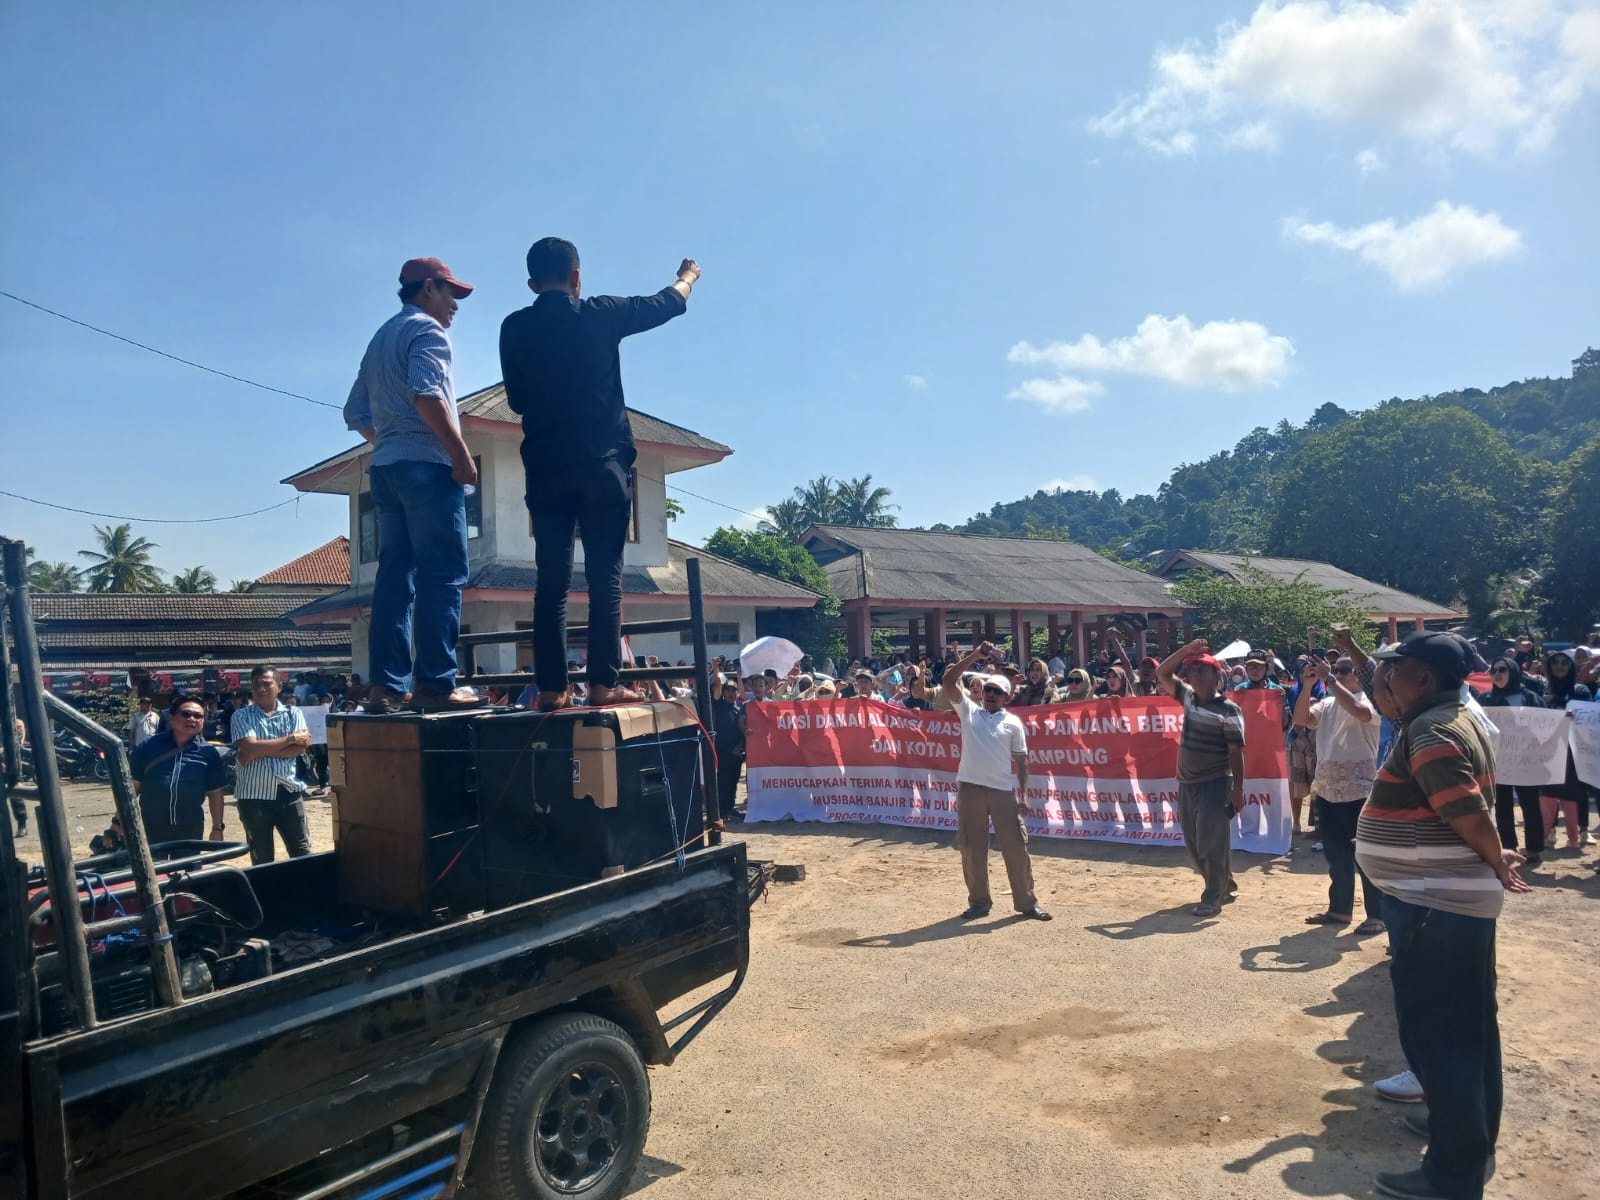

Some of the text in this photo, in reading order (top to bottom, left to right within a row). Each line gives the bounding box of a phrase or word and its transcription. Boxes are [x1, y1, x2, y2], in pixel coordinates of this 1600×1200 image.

[777, 714, 811, 729] AKSI
[815, 713, 862, 729] DAMAI
[927, 720, 961, 736] MAS
[1043, 715, 1131, 736] PANJANG
[1137, 714, 1184, 733] BERS
[871, 738, 902, 754] DAN
[905, 740, 946, 758] KOTA
[1028, 749, 1108, 765] AMPUNG
[762, 777, 847, 789] MENGUCAPKAN
[849, 778, 891, 789] TERIMA
[894, 779, 928, 791] KASIH
[930, 780, 958, 793] ATAS
[813, 794, 863, 806] MUSIBAH
[866, 795, 905, 808] BANJIR
[909, 798, 931, 810] DAN
[934, 800, 958, 812] DUK
[1056, 809, 1119, 822] SELURUH
[1124, 811, 1180, 824] KEBIJA
